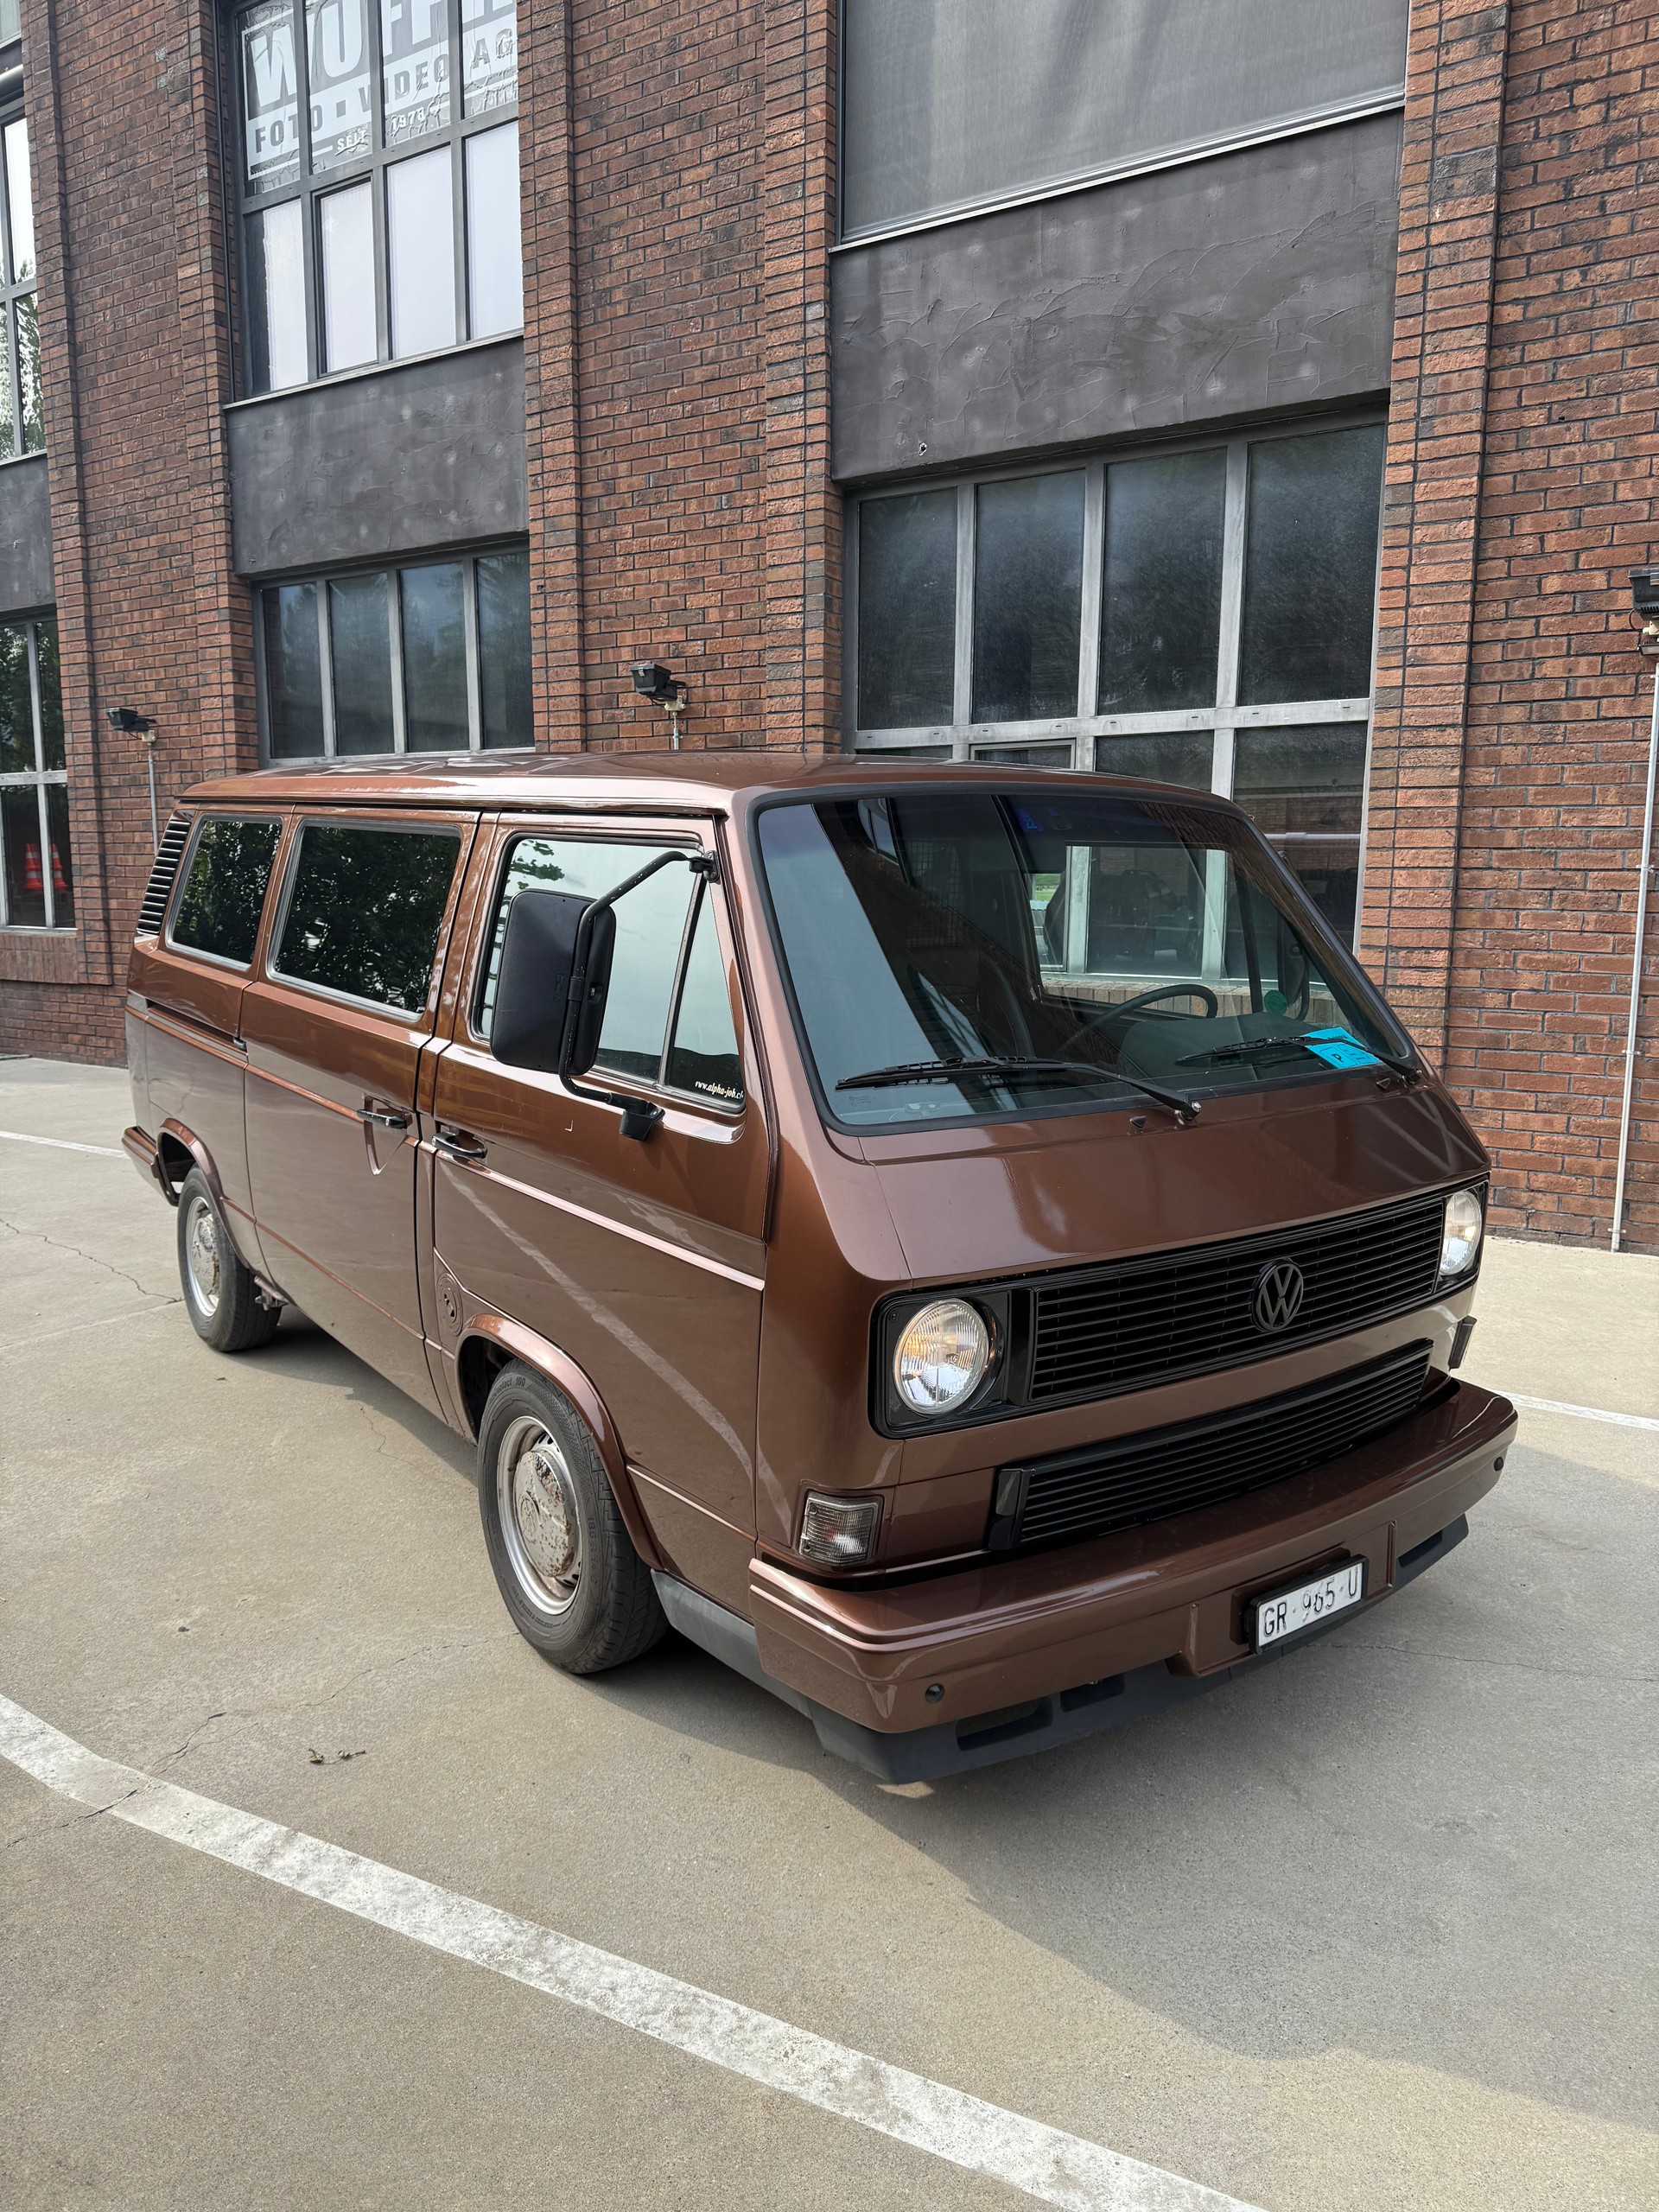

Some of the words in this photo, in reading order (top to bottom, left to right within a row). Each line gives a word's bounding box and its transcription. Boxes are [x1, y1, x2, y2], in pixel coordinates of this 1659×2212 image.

[255, 105, 323, 154] FOTO
[358, 54, 449, 112] VIDEO
[473, 29, 513, 69] AG
[1331, 1053, 1344, 1064] P
[1258, 1264, 1303, 1329] VW
[1263, 1601, 1287, 1636] GR
